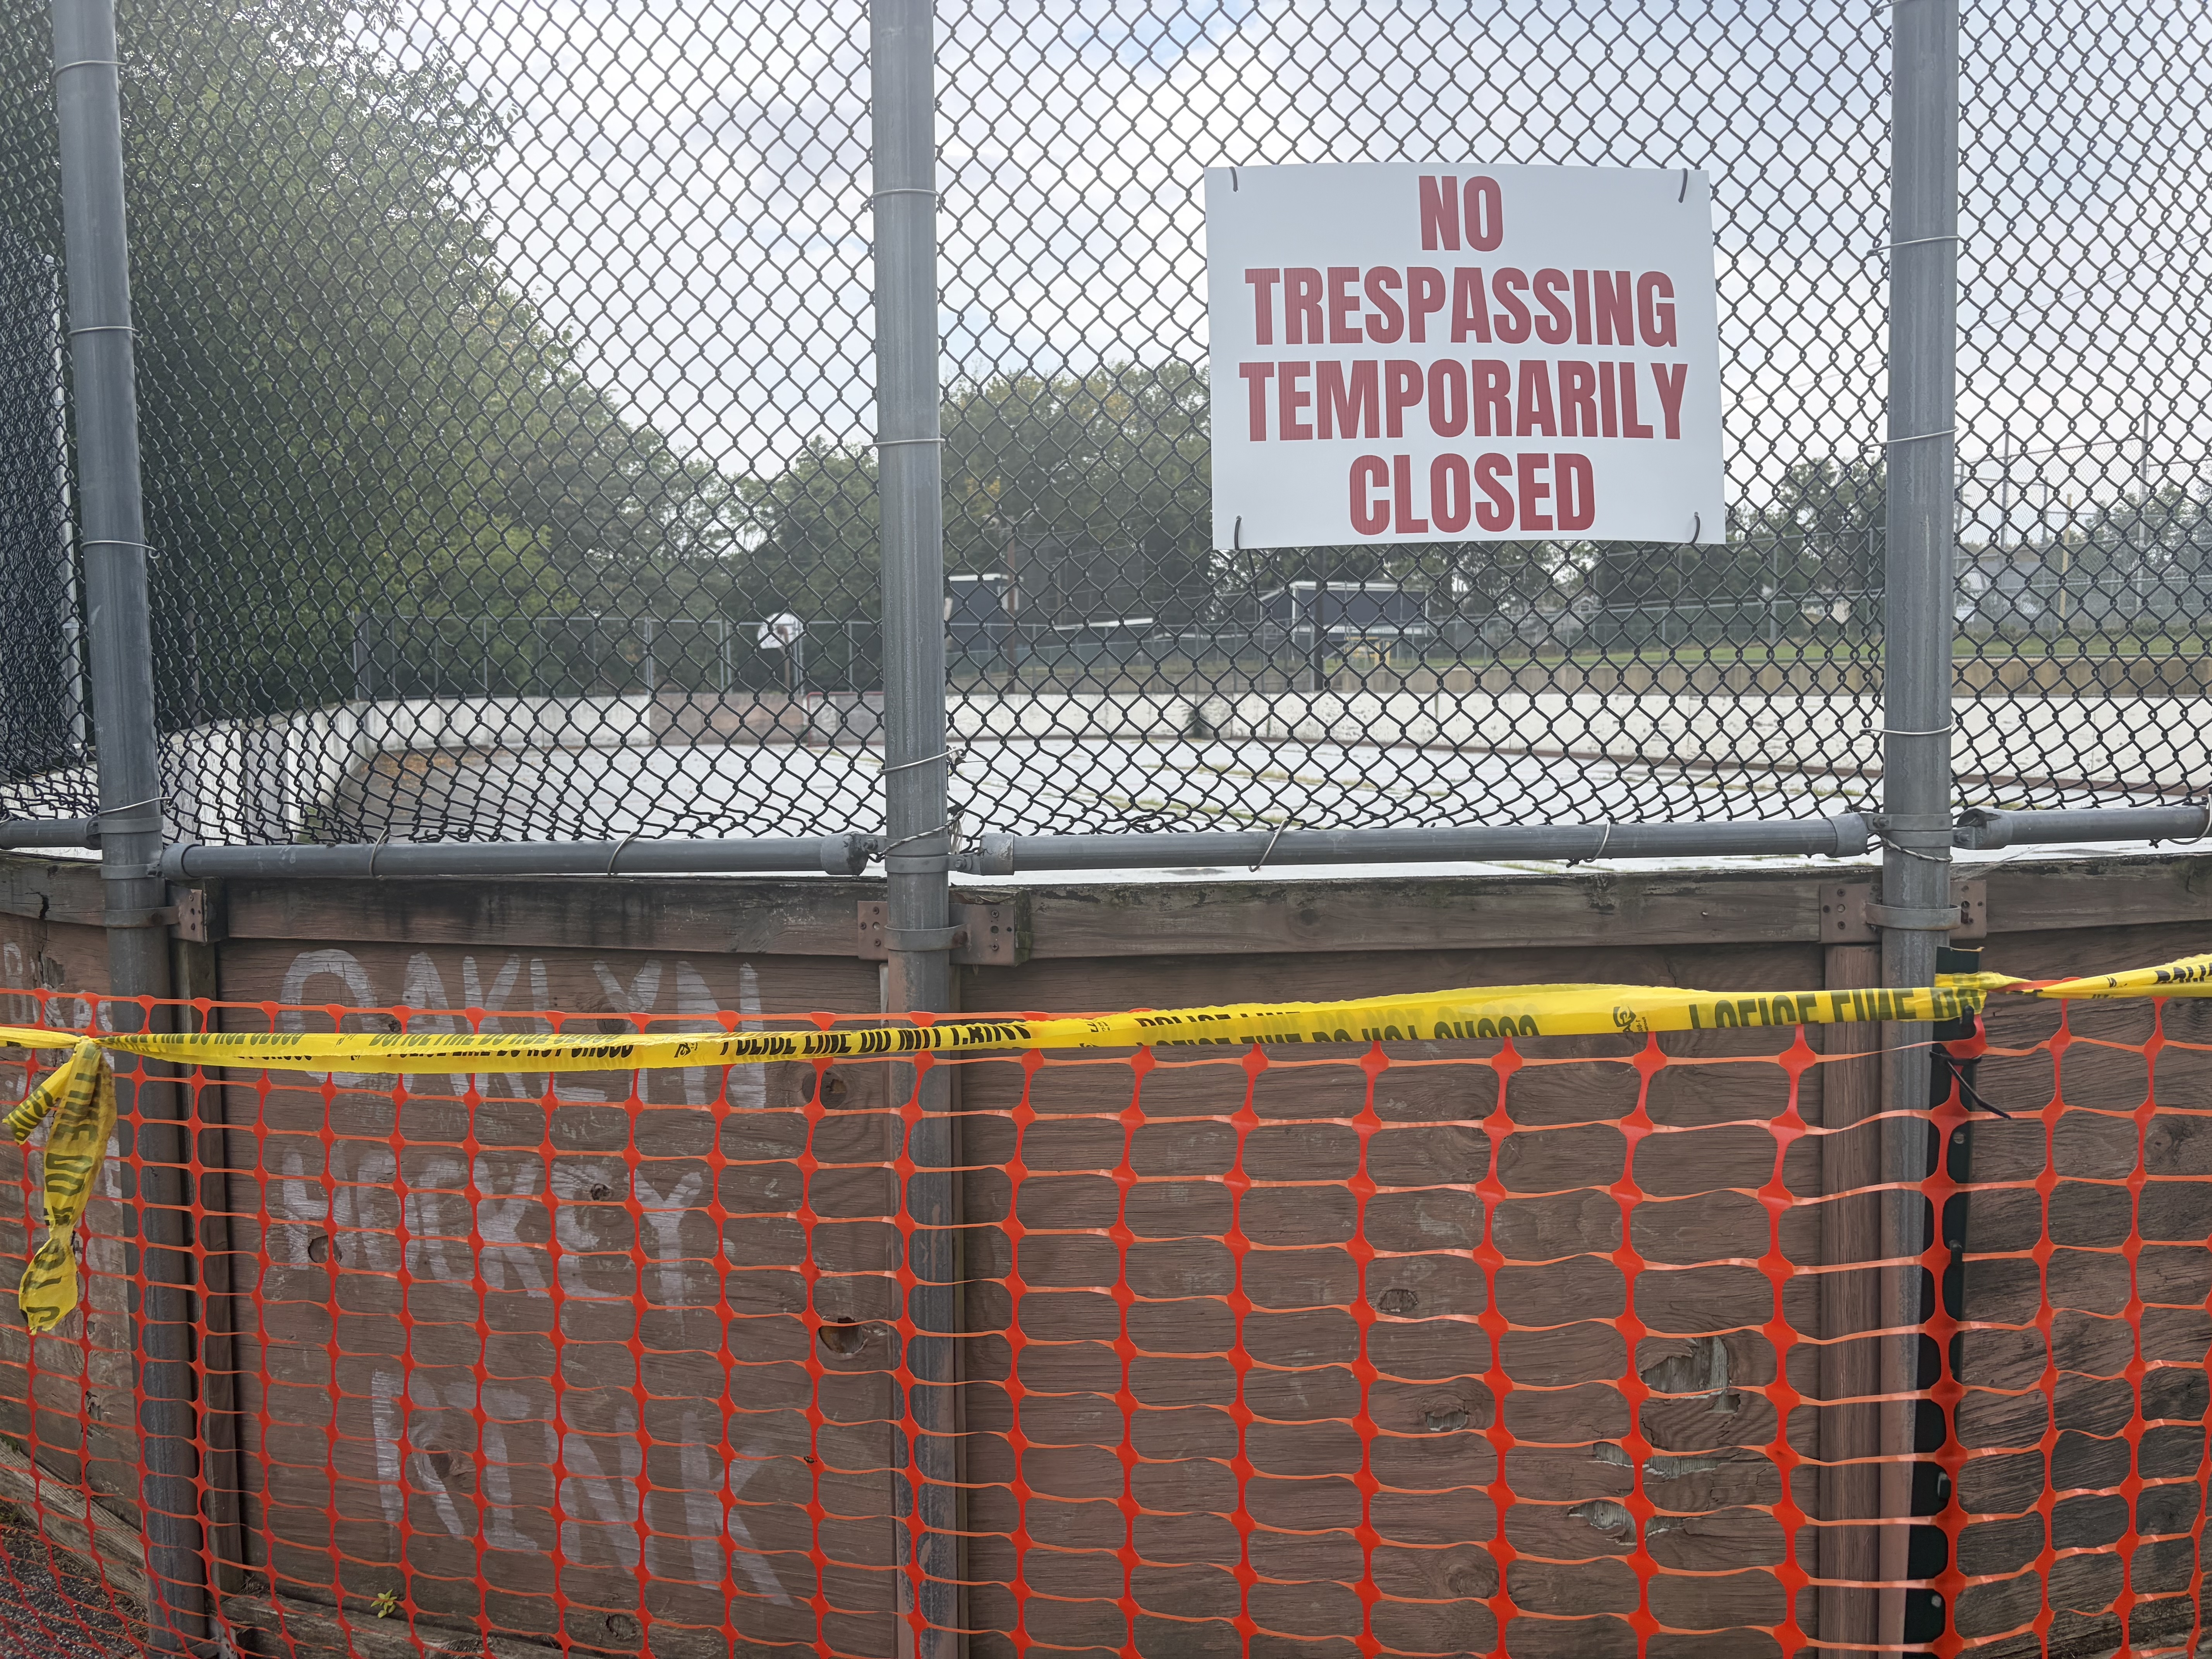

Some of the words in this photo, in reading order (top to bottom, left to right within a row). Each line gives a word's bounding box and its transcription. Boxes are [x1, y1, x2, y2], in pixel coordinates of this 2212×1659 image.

[1419, 175, 1503, 252] NO
[1245, 266, 1677, 347] TRESPASSING
[1239, 359, 1688, 441] TEMPORARILY
[1349, 453, 1595, 535] CLOSED
[280, 949, 766, 1109] OAKLYN
[282, 1146, 701, 1313] HOCKEY
[371, 1368, 793, 1607] RINK
